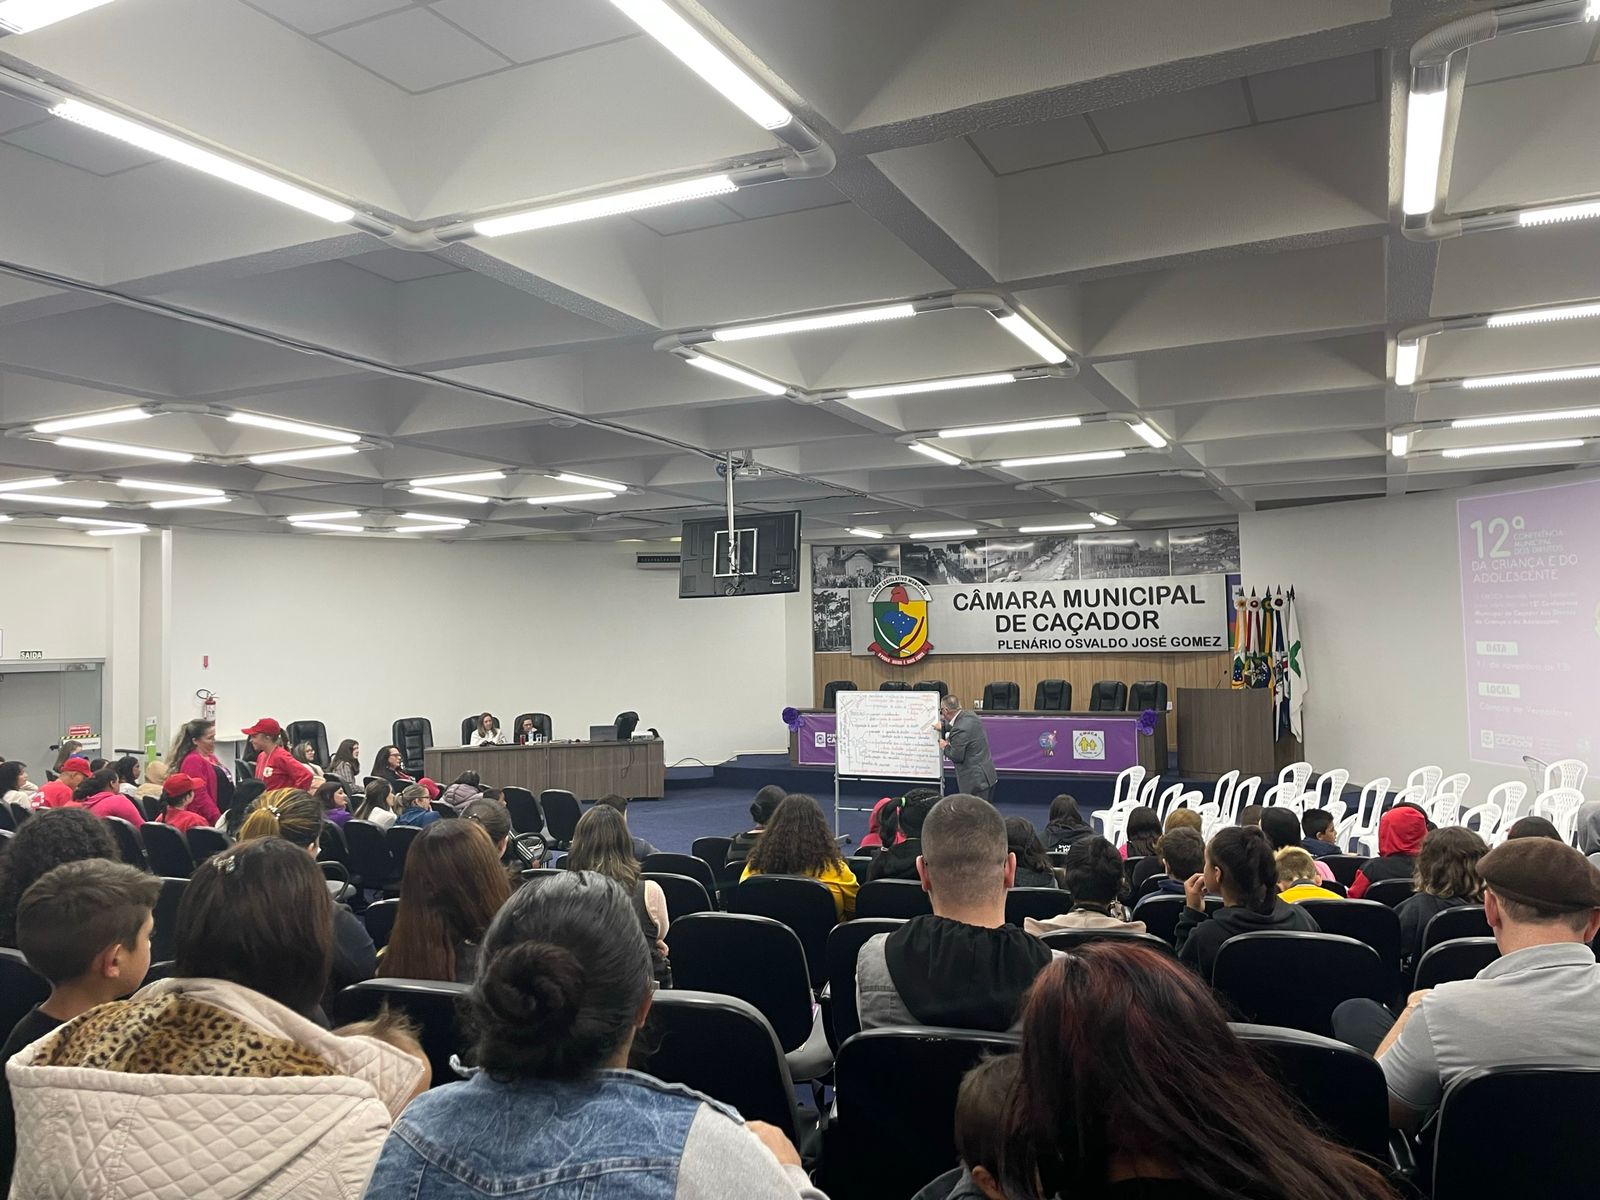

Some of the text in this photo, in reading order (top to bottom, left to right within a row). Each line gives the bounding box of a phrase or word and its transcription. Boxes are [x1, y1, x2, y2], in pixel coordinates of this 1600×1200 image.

[1491, 557, 1545, 570] CRIANÇA
[1548, 556, 1557, 567] E
[1559, 554, 1579, 566] DO
[1473, 568, 1560, 584] ADOLESCENTE
[953, 584, 1206, 611] CÂMARA MUNICIPAL
[995, 610, 1160, 636] DE CAÇADOR
[998, 635, 1222, 650] PLENÁRIO OSVALDO JOSÉ GOMEZ
[1485, 643, 1507, 653] DATA
[1486, 684, 1512, 695] LOCAL
